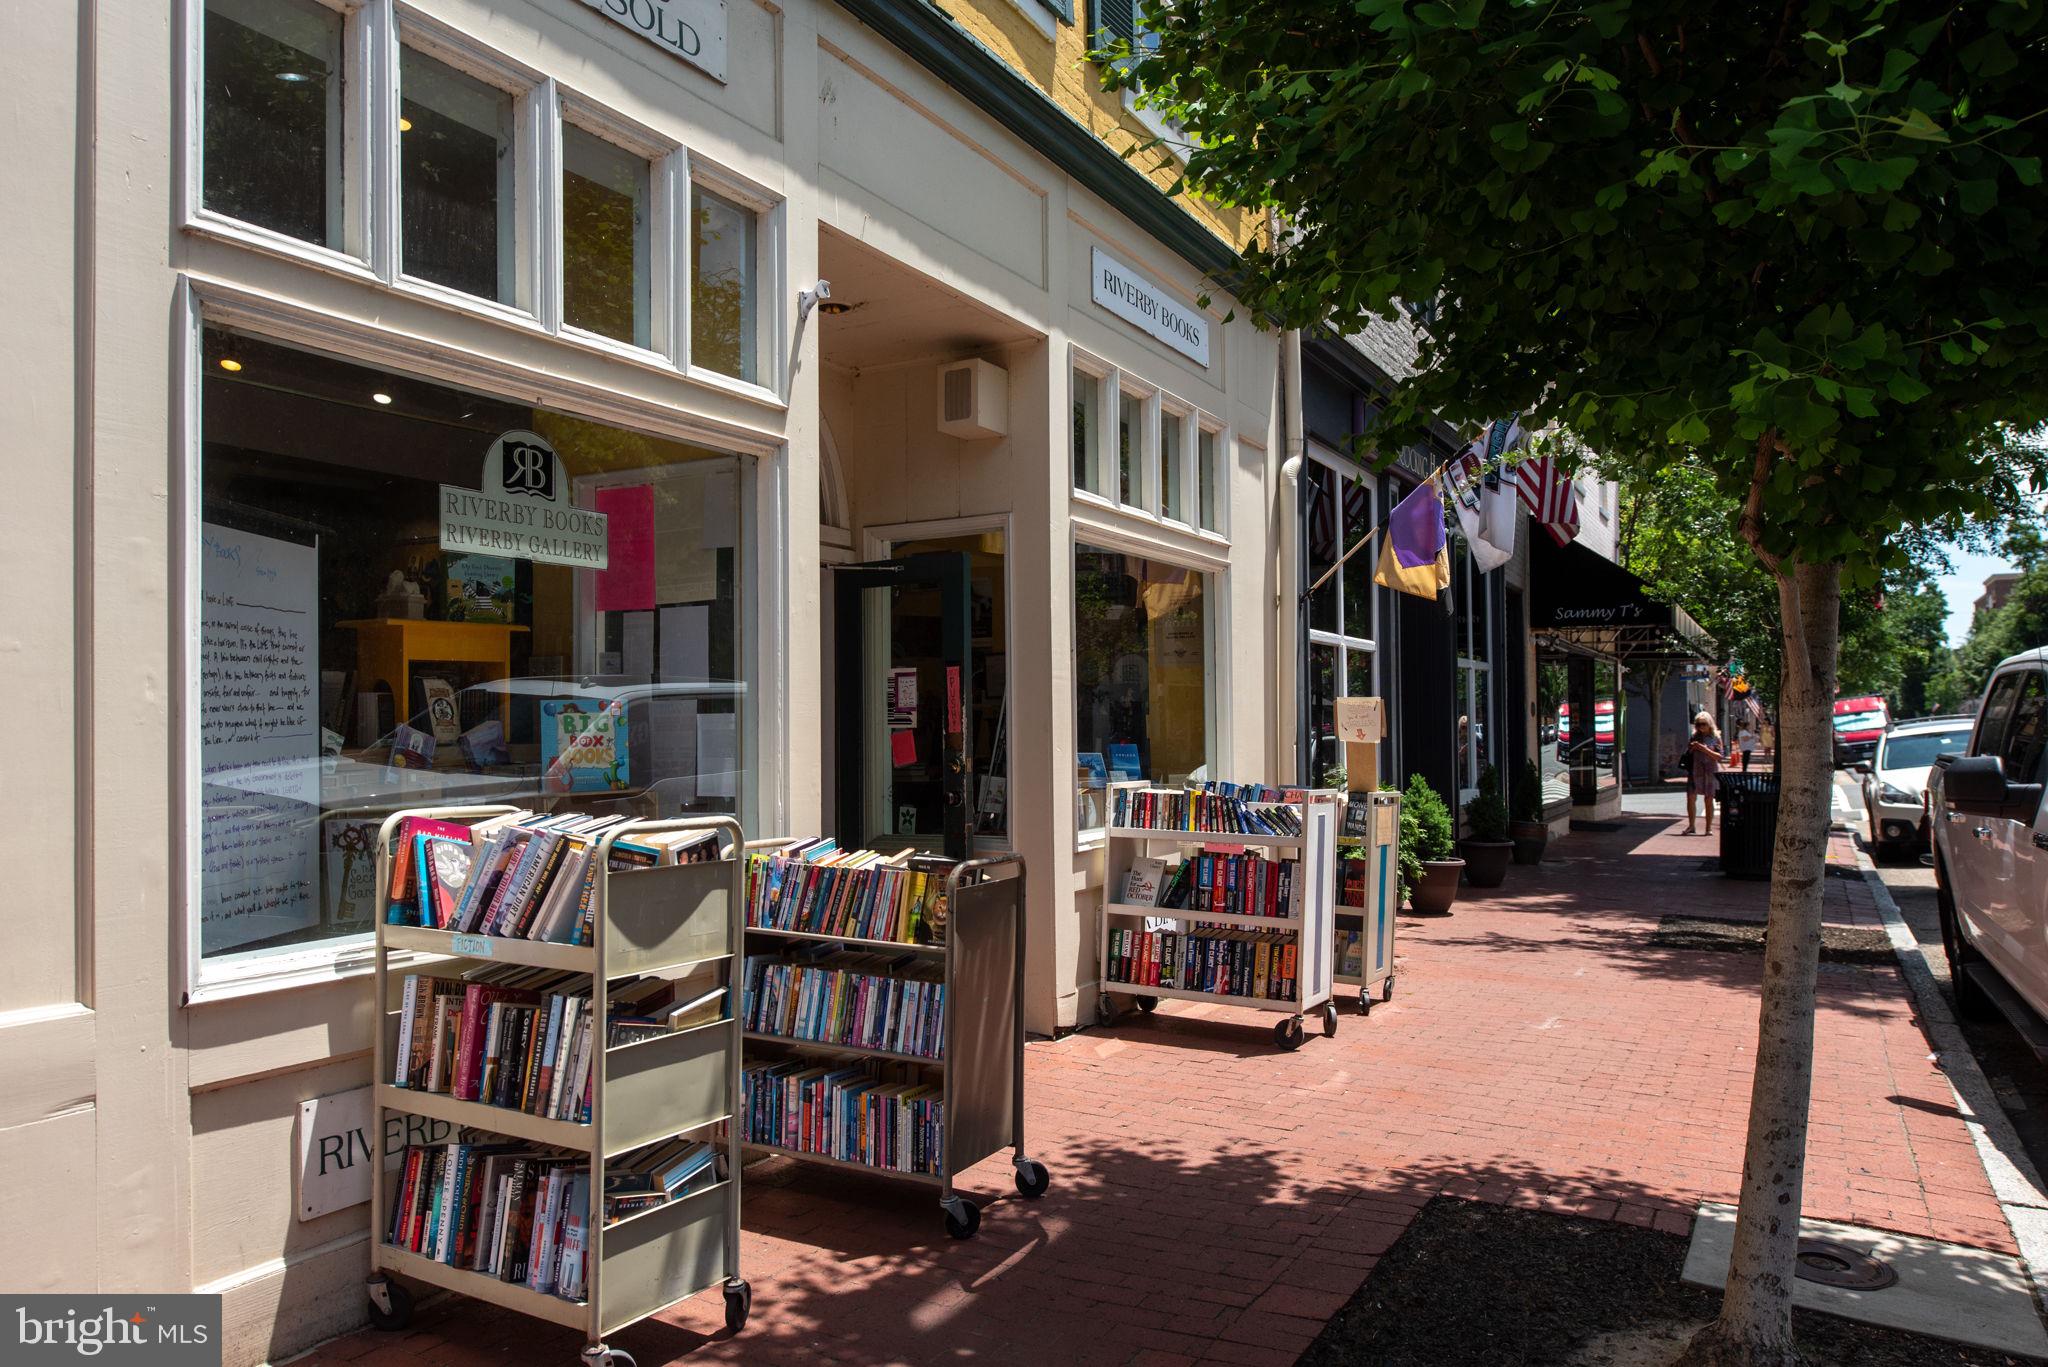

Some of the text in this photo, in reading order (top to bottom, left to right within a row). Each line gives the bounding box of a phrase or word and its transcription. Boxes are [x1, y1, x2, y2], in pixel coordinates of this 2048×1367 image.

[1104, 269, 1200, 347] RIVERBY BOOKS
[446, 492, 605, 537] RIVERBY BOOKS
[446, 523, 603, 562] RIVERBY GALLERY
[1555, 603, 1643, 620] Sammy T's
[563, 714, 609, 734] BIG
[510, 848, 521, 866] RUBY
[508, 854, 542, 918] AMERICAN DIRT
[456, 936, 486, 954] FICTION
[416, 979, 427, 1019] DAN BROWN
[520, 1018, 530, 1049] GREY
[531, 1053, 541, 1076] WITHOUT
[529, 1076, 538, 1097] BREATH
[437, 1154, 454, 1244] LOUISE PENNY
[452, 1150, 465, 1210] JODI PICOULT
[513, 1163, 525, 1201] SALMAN
